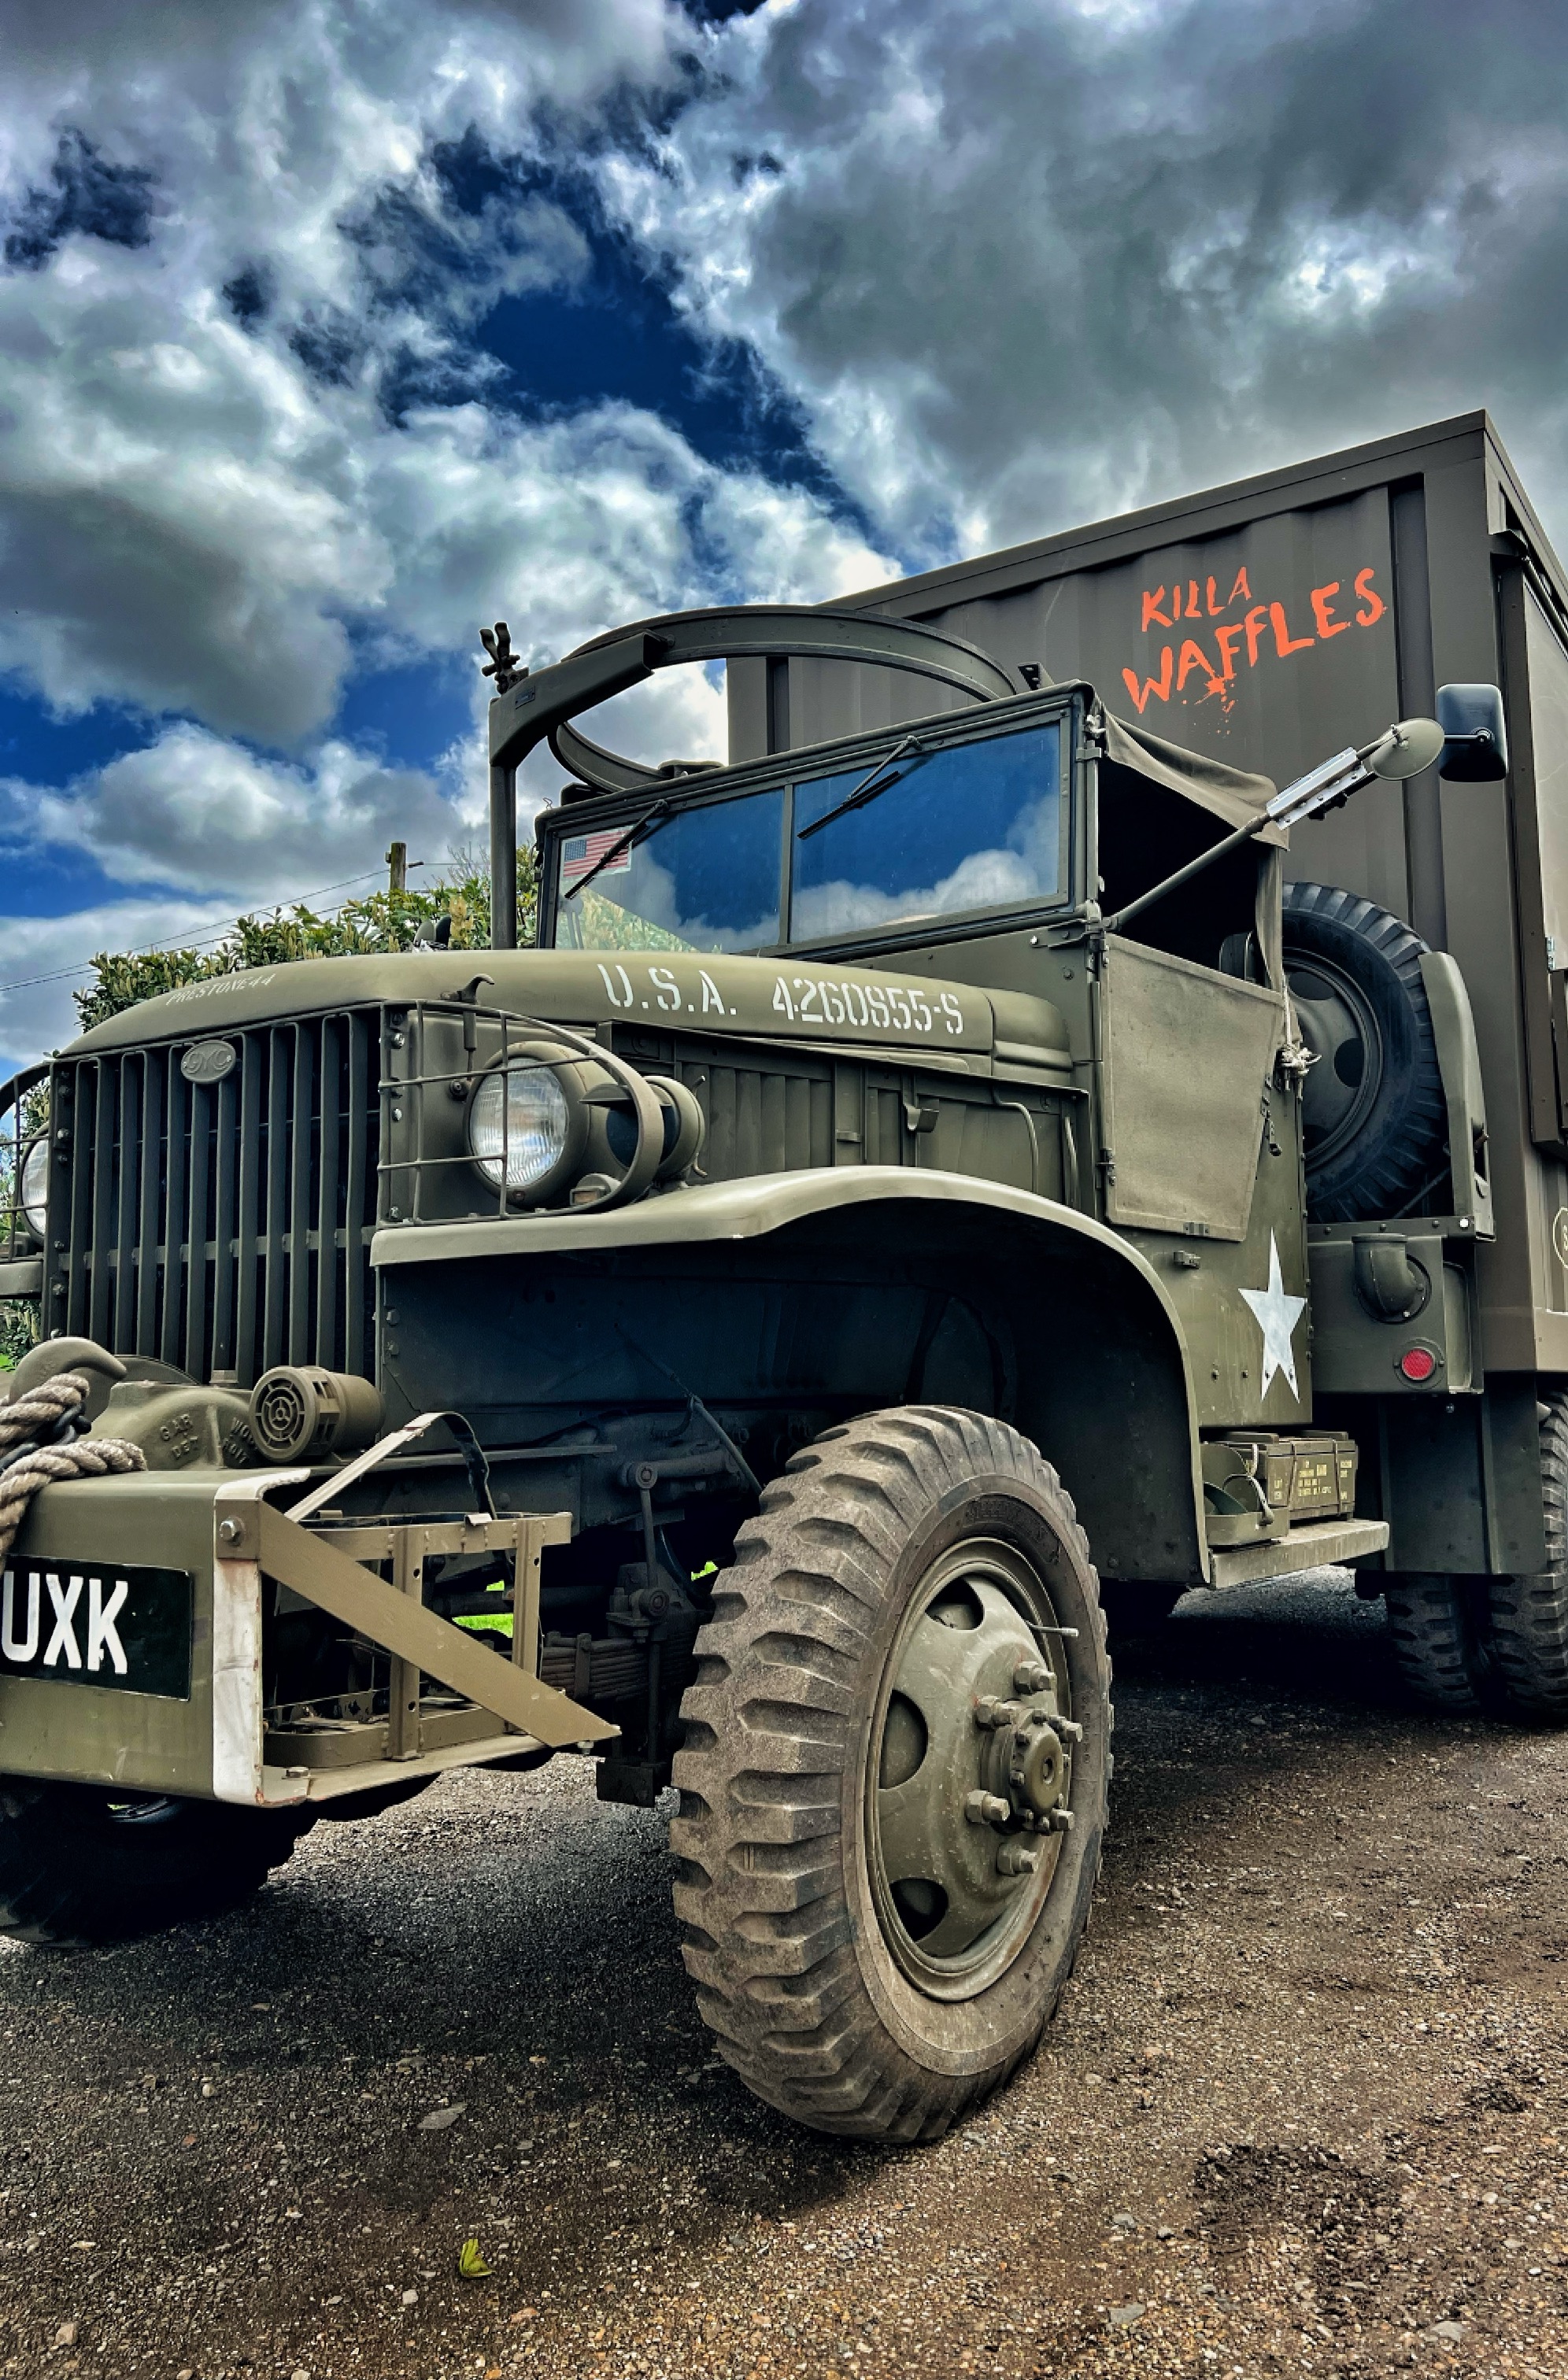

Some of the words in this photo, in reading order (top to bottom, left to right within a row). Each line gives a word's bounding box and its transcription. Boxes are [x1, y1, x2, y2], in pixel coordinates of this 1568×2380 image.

[1122, 567, 1388, 714] WAFFLES
[1141, 567, 1252, 633] KILLA
[597, 963, 738, 1016] U.S.A.
[771, 976, 963, 1035] 4260855-S
[2, 1570, 128, 1675] UXK
